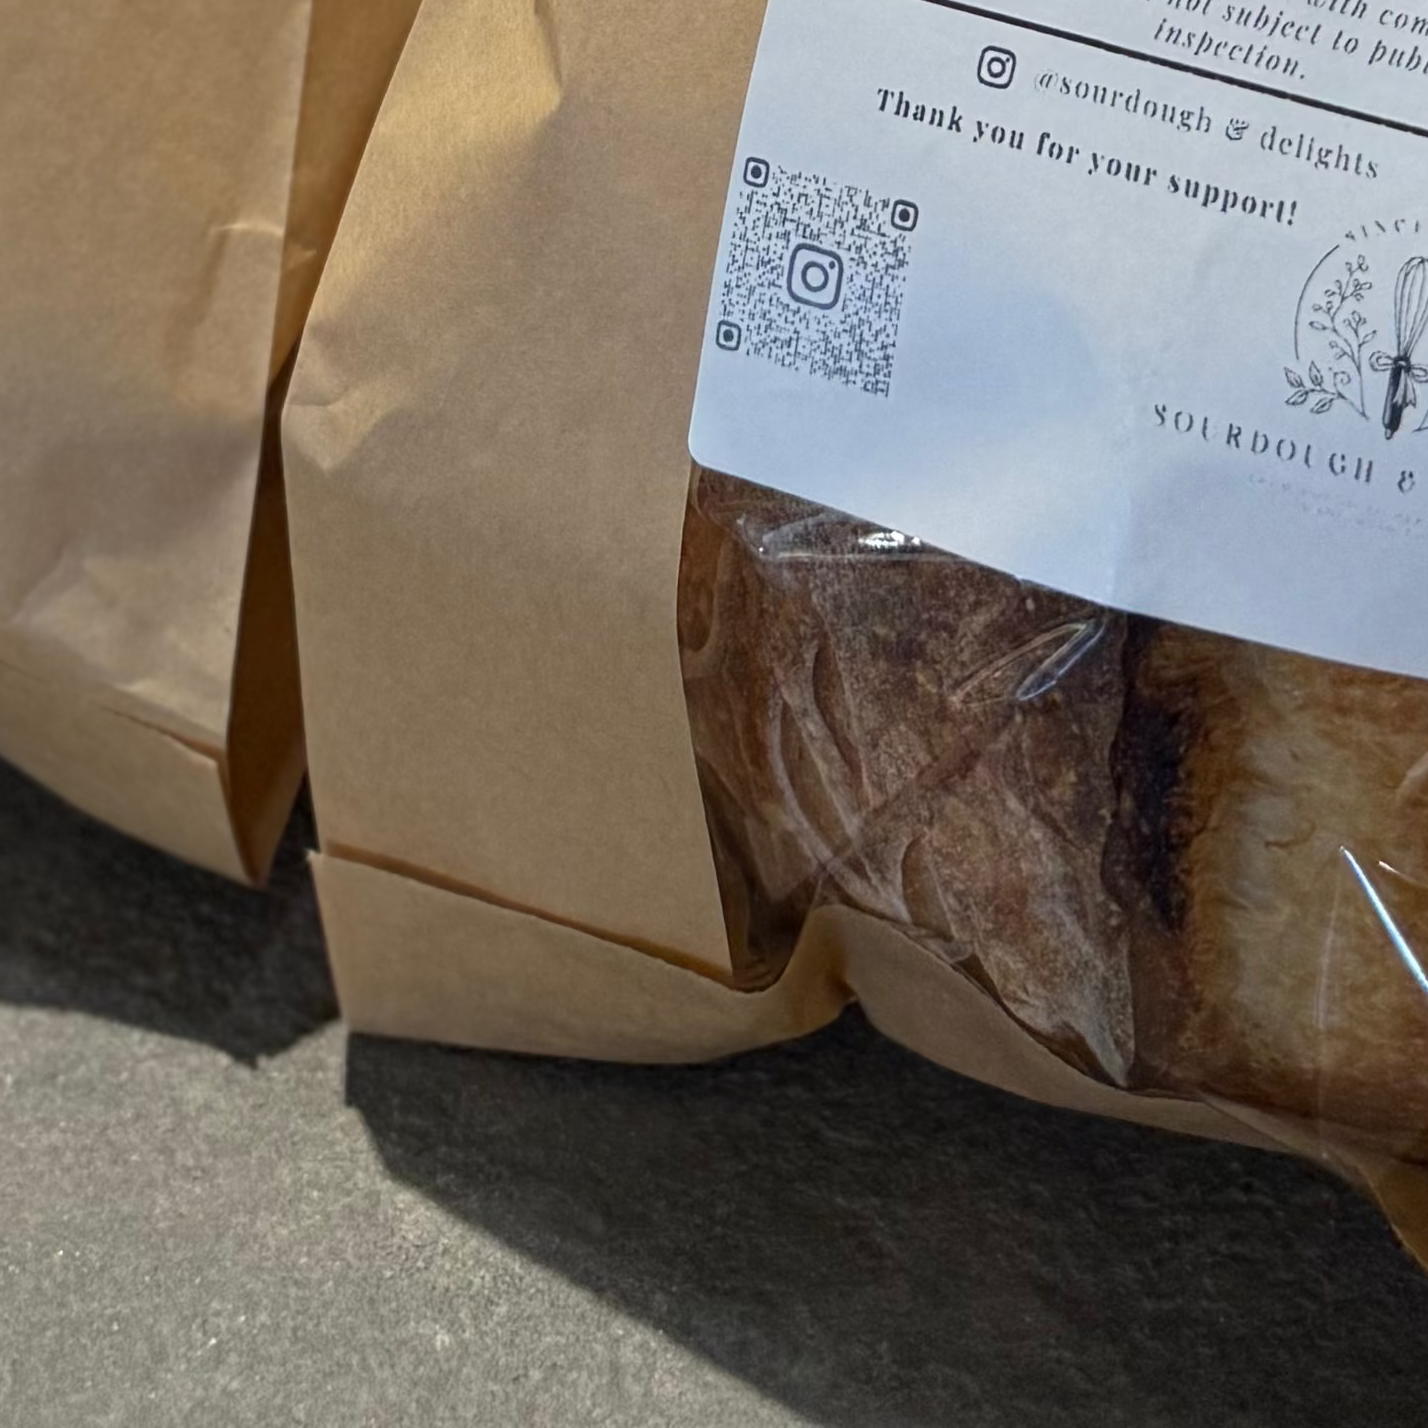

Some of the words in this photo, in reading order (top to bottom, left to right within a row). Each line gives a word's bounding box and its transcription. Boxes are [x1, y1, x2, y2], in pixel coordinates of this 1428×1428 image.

[1153, 17, 1307, 81] inspection.
[1221, 2, 1322, 45] subject
[1332, 28, 1360, 55] to
[875, 87, 965, 134] Thank
[972, 118, 1026, 151] you
[1035, 131, 1080, 167] for
[1086, 148, 1159, 188] your
[1167, 171, 1299, 228] support!
[1032, 68, 1214, 135] @sourdough
[1225, 117, 1250, 142] &
[1260, 124, 1380, 181] delights
[1152, 402, 1375, 484] SOURDOUGH
[1397, 469, 1416, 494] &
